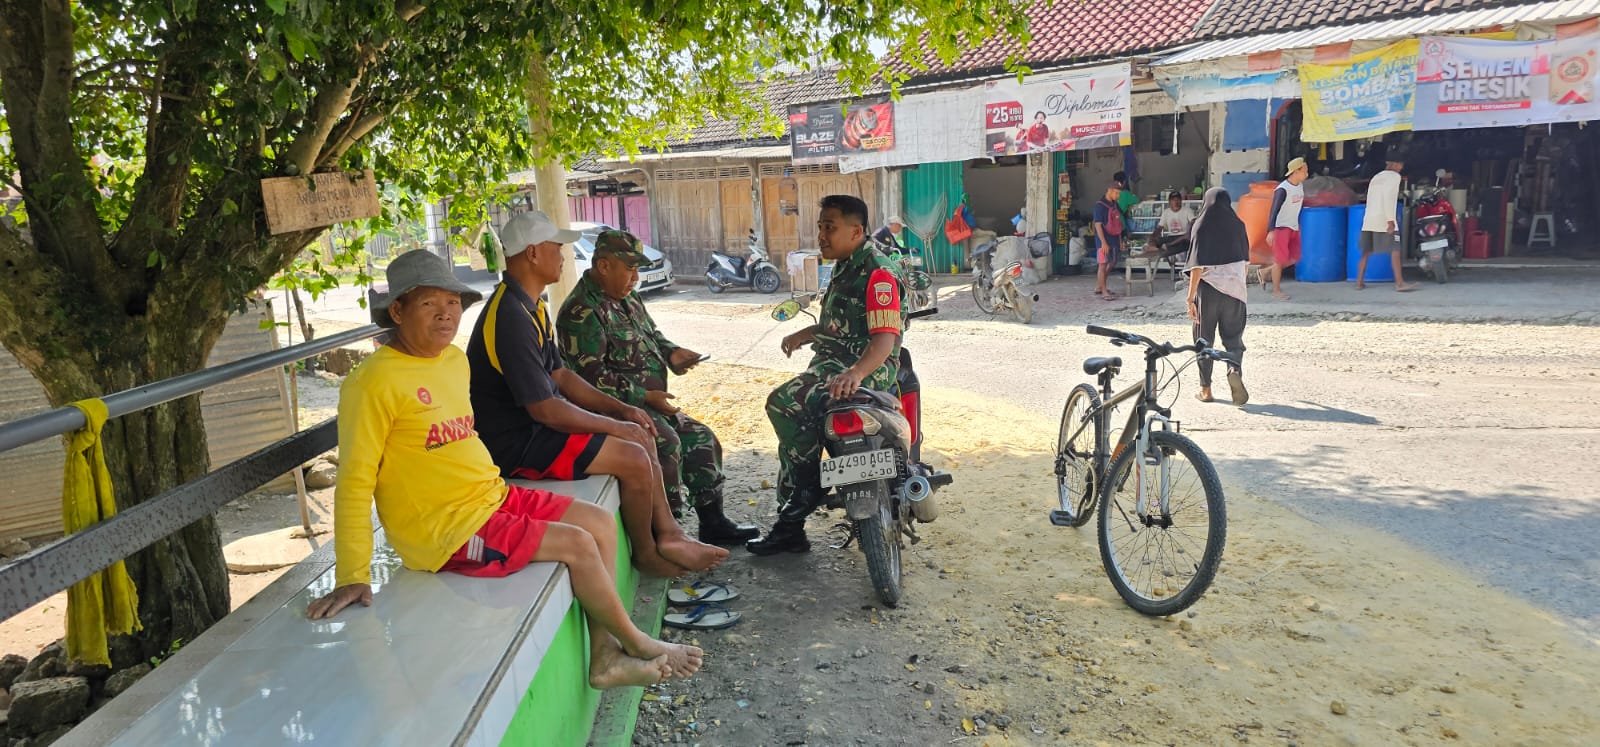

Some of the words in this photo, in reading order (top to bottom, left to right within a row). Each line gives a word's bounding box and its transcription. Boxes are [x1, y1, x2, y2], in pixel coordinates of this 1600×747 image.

[1442, 57, 1530, 79] SEMEN
[1439, 76, 1530, 101] GRESIK
[992, 106, 1009, 124] 25
[796, 131, 835, 144] BLAZE
[822, 460, 836, 473] AD
[838, 455, 866, 469] 4490
[869, 451, 893, 467] AGE
